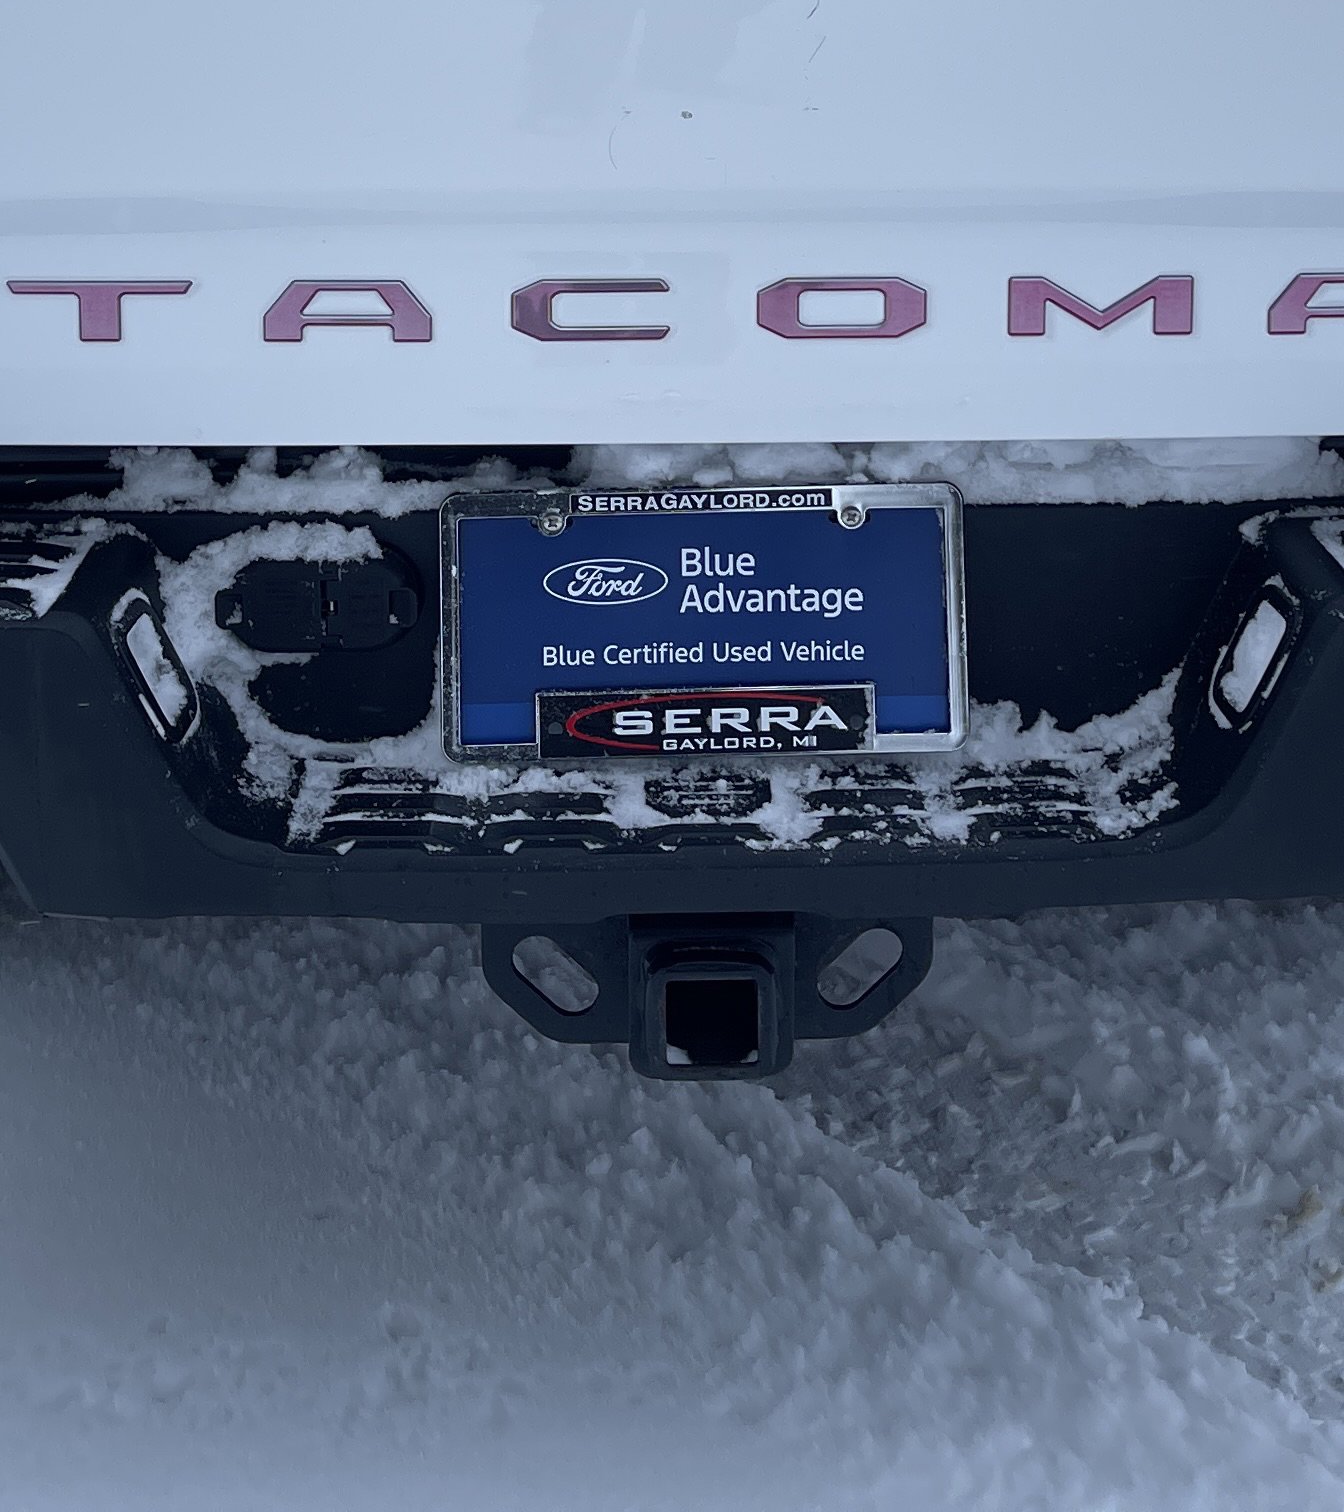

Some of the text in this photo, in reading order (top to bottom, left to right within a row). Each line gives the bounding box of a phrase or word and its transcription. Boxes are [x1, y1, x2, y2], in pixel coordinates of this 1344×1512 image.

[577, 490, 826, 513] SERRAGAYLORD.com
[680, 546, 756, 577] Blue
[567, 564, 645, 598] Ford
[679, 582, 864, 618] Advantage
[542, 639, 866, 666] Blue Certified Used Vehicle
[613, 704, 848, 736] SERRA
[662, 735, 817, 751] GAYLORD, MI
